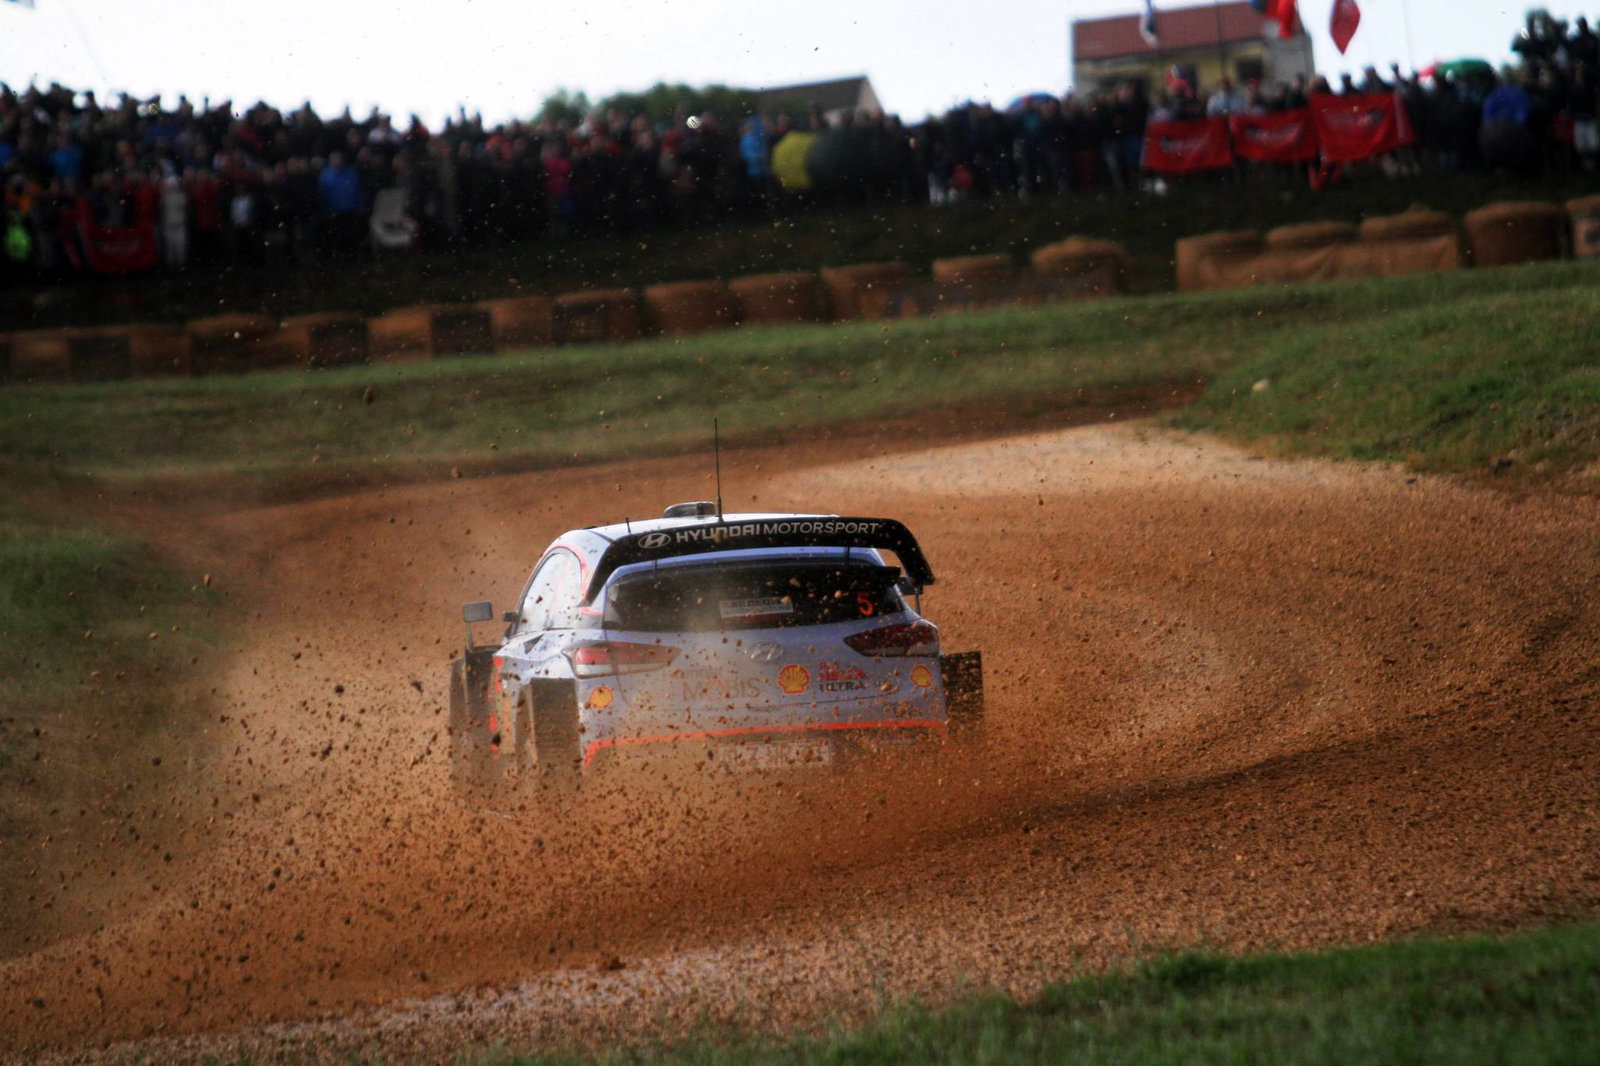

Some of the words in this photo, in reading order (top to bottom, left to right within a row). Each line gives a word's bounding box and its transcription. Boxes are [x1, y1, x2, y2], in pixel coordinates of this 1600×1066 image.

[676, 524, 760, 543] HYUNDAI
[763, 521, 880, 535] MOTORSPORT
[856, 591, 874, 616] 5
